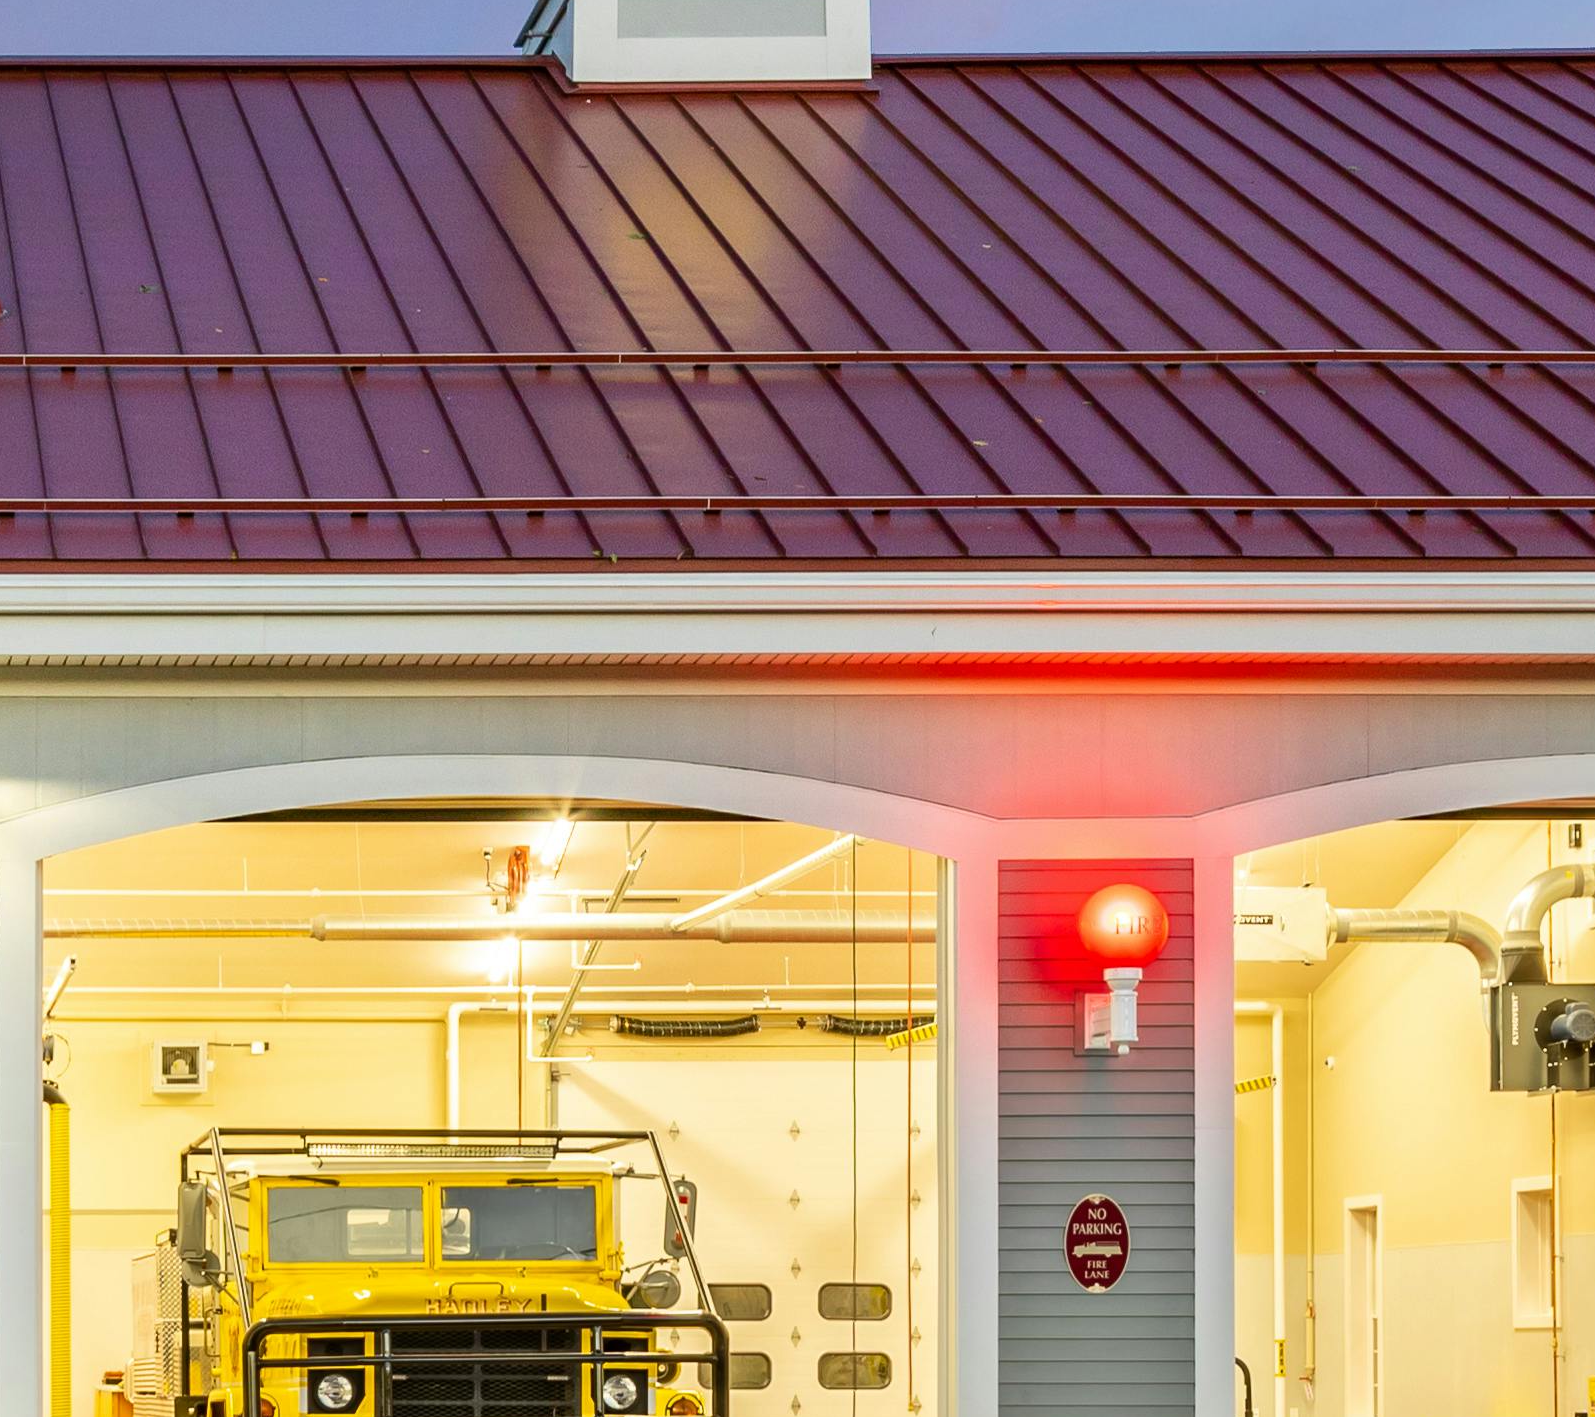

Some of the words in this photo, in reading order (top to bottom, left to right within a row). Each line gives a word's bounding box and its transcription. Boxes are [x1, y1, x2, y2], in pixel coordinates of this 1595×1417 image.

[1088, 1208, 1107, 1220] NO
[1073, 1223, 1122, 1235] PARKING
[1087, 1260, 1107, 1269] FIRE
[1084, 1270, 1110, 1279] LANE
